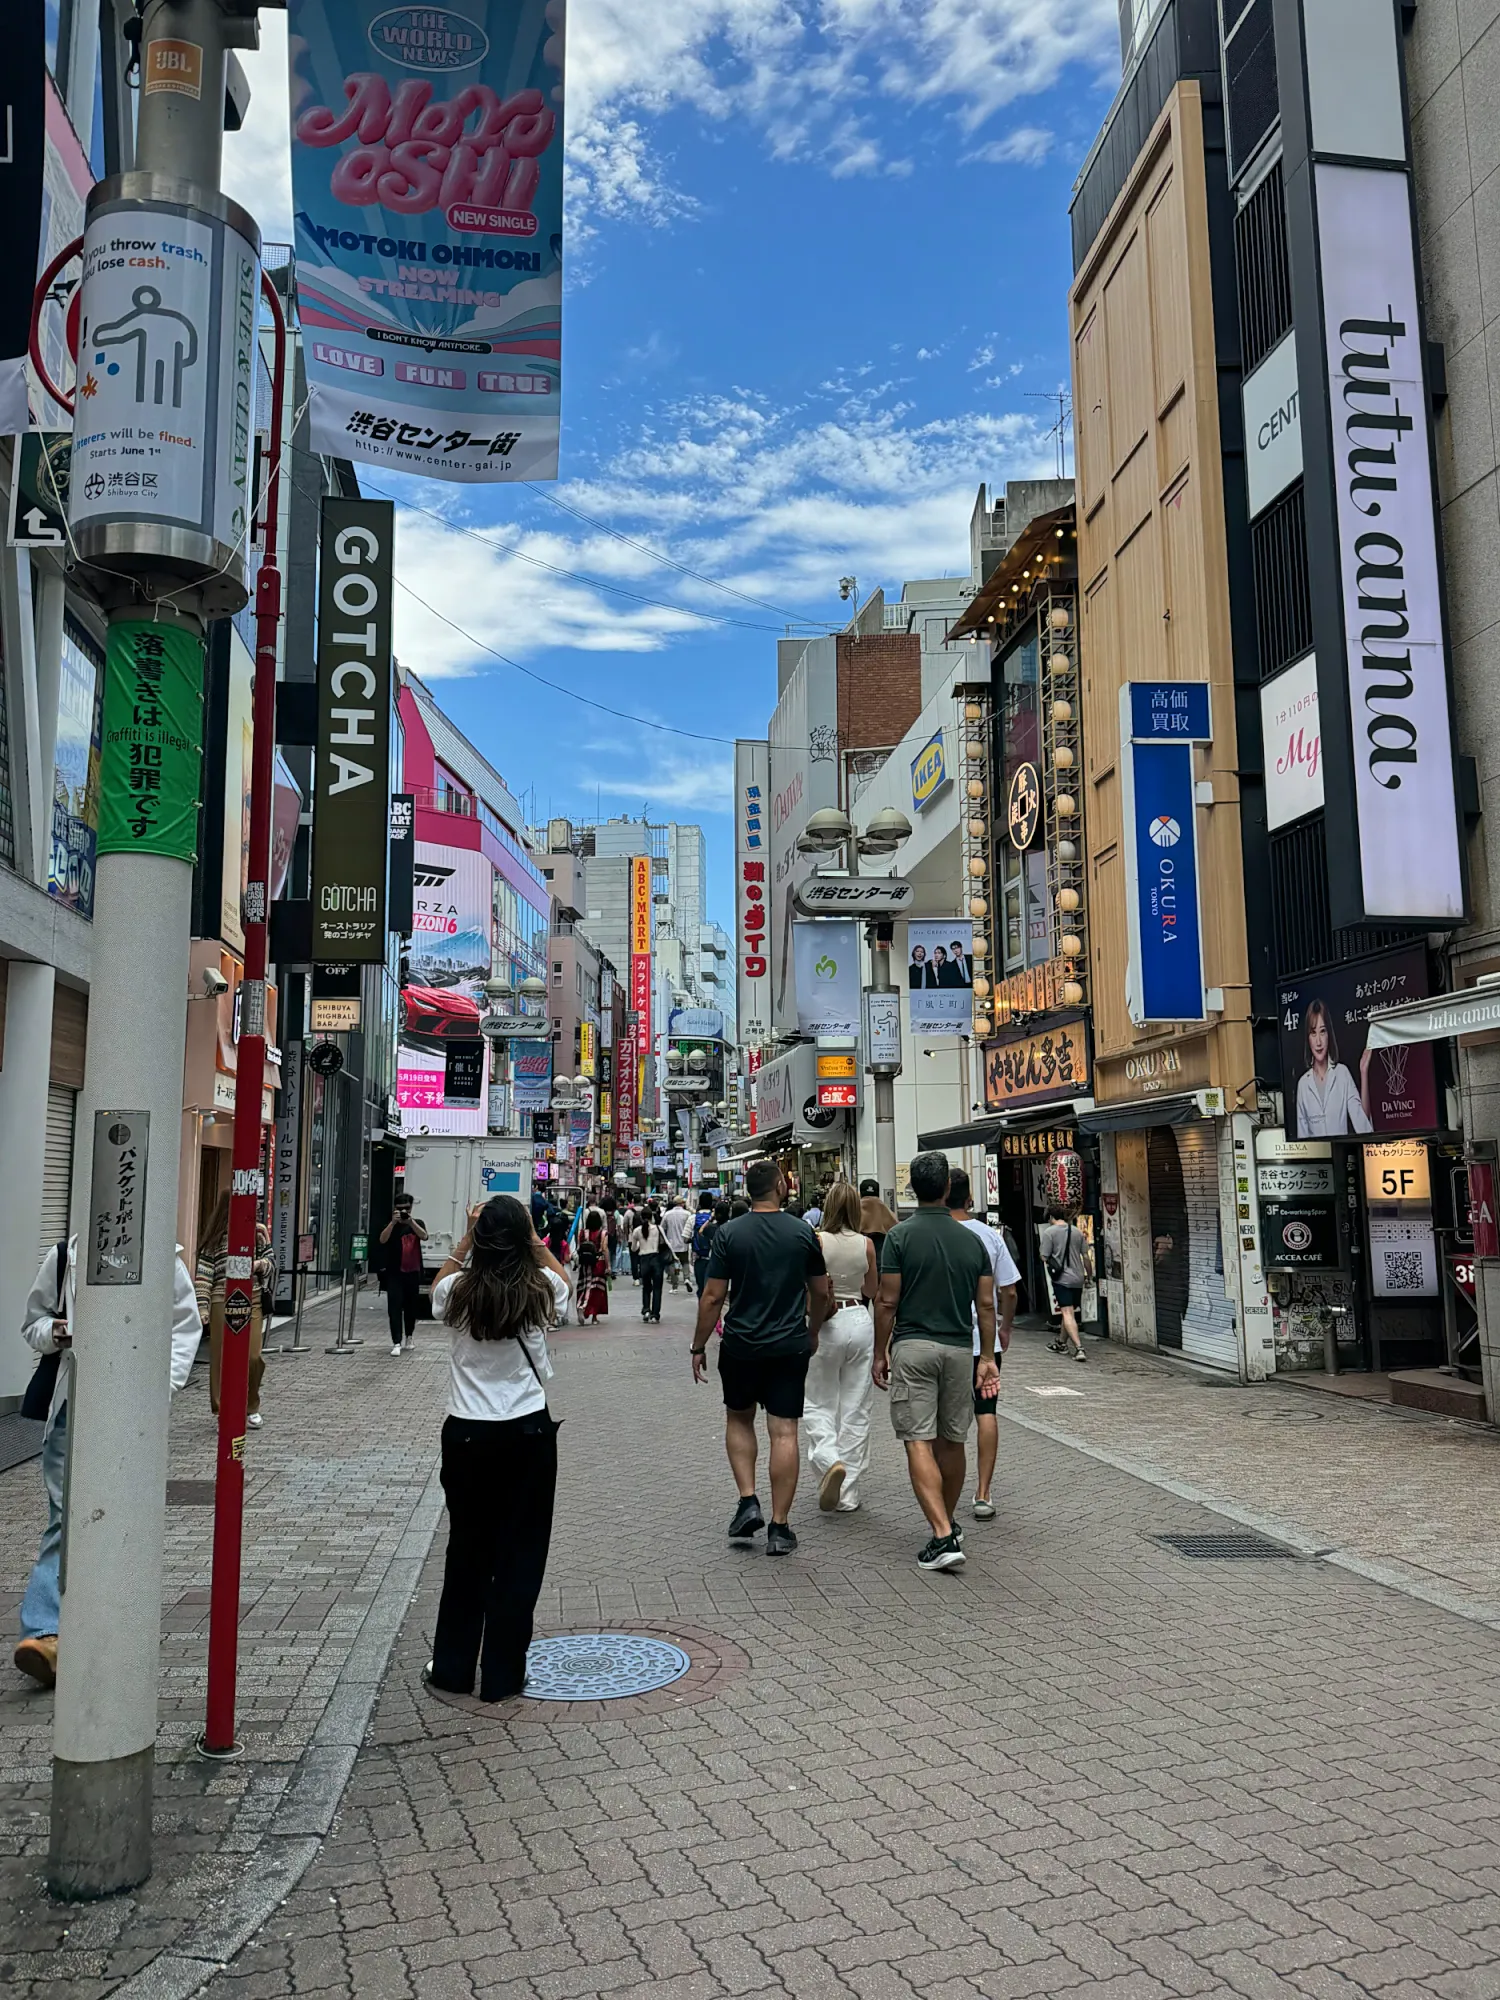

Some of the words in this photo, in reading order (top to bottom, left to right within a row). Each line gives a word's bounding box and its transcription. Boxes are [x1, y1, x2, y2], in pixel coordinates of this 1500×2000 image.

[409, 12, 448, 31] THE
[382, 26, 472, 51] WORLD
[156, 50, 192, 73] JBL
[402, 47, 461, 65] NEWS
[453, 209, 488, 225] NEW
[488, 213, 535, 230] SINGLE
[110, 238, 156, 251] throw
[161, 240, 208, 267] trash,
[316, 225, 427, 262] MOTOKI
[432, 244, 541, 272] OHMORI
[97, 257, 125, 272] lose
[128, 256, 171, 271] cash.
[398, 265, 460, 286] NOW
[358, 275, 501, 307] STREAMING
[238, 259, 254, 348] SAFE
[376, 331, 381, 339] I
[410, 336, 437, 348] KNOW
[316, 345, 377, 374] LOVE
[406, 365, 453, 387] FUN
[482, 374, 549, 393] TRUE
[1339, 304, 1414, 516] tutu
[110, 428, 133, 440] will
[138, 428, 154, 440] be
[159, 431, 197, 449] fined.
[345, 410, 522, 456] 渋谷センター街
[90, 448, 117, 459] Starts
[120, 446, 145, 456] June
[108, 471, 159, 488] 渋谷区
[107, 488, 139, 498] Shibuya
[141, 489, 159, 498] City
[328, 525, 380, 796] GOTCHA
[1353, 531, 1418, 790] anna
[1151, 689, 1188, 709] 高価
[1151, 712, 1189, 732] 買取
[106, 726, 142, 744] Graffiti
[145, 728, 155, 743] is
[157, 730, 190, 751] illegal
[1276, 726, 1321, 777] My
[915, 751, 942, 789] IKEA
[391, 816, 412, 826] ART
[806, 886, 911, 900] 渋谷センター街
[1150, 886, 1158, 917] TOKYO
[1159, 858, 1178, 944] OKURA
[416, 900, 458, 916] RZA
[320, 921, 377, 931] オーストラリア
[323, 930, 372, 940] 発のゴッチャ
[447, 918, 457, 934] 6
[325, 966, 350, 976] OFF
[1355, 975, 1407, 998] あなたのクマ
[1280, 990, 1299, 1005] 当ビル
[483, 1021, 547, 1030] 渋谷センター街
[748, 1019, 763, 1027] 渋谷
[1283, 1007, 1300, 1032] 4F
[745, 1027, 766, 1035] 2号店
[1125, 1048, 1181, 1081] OKURA
[1366, 1148, 1425, 1157] れいわクリニック
[482, 1159, 522, 1168] Takanashi
[1260, 1169, 1329, 1180] 渋谷センター街
[1382, 1169, 1414, 1196] 5F
[1260, 1181, 1329, 1191] れいわクリニック
[1265, 1204, 1280, 1216] 3F
[280, 1211, 289, 1244] SHIBUYA
[1303, 1253, 1323, 1261] CAFÉ
